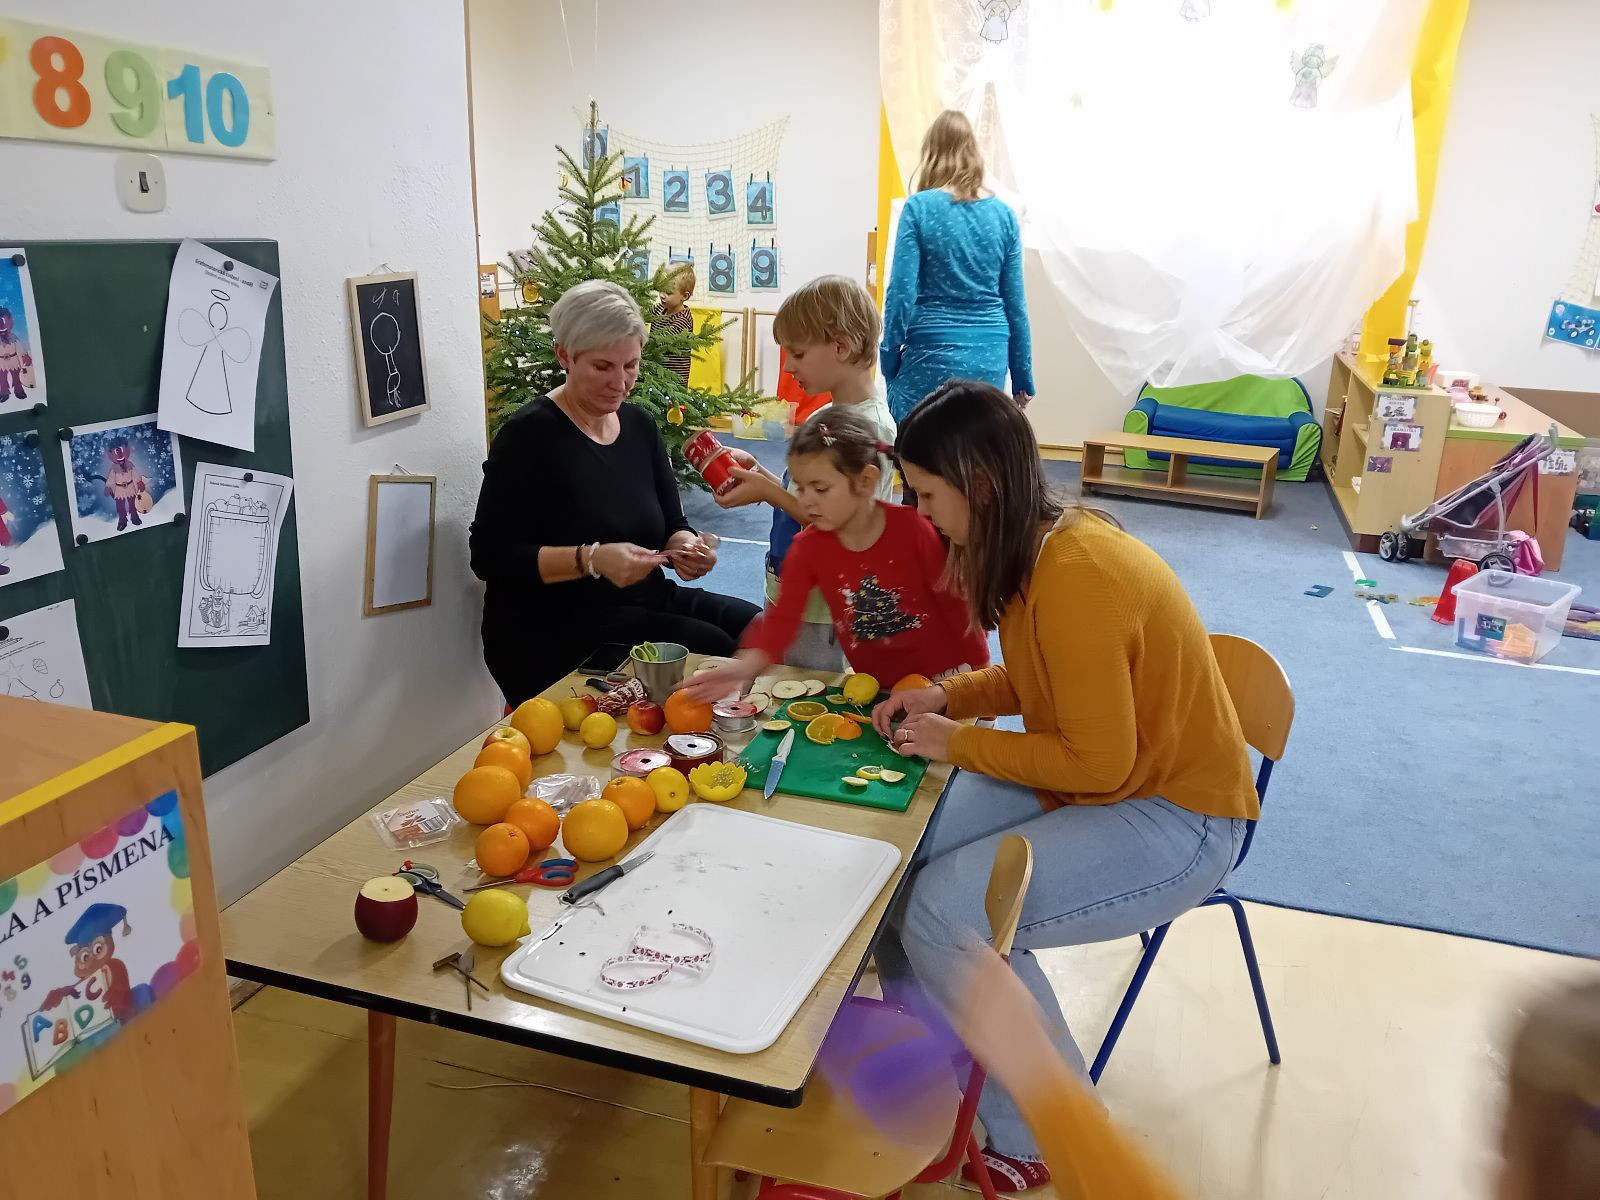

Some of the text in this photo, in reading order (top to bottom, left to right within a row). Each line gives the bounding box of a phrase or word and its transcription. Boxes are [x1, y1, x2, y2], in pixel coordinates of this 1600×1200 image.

[30, 36, 249, 147] 8 9 10
[623, 162, 641, 196] 1
[666, 175, 689, 208] 2
[707, 174, 732, 211] 3
[749, 186, 771, 220] 4
[710, 254, 732, 290] 8
[752, 249, 775, 285] 9
[32, 898, 54, 925] A
[55, 824, 176, 909] PÍSMENA
[21, 973, 31, 990] 9
[85, 976, 103, 1001] C
[32, 1004, 94, 1046] A B D
